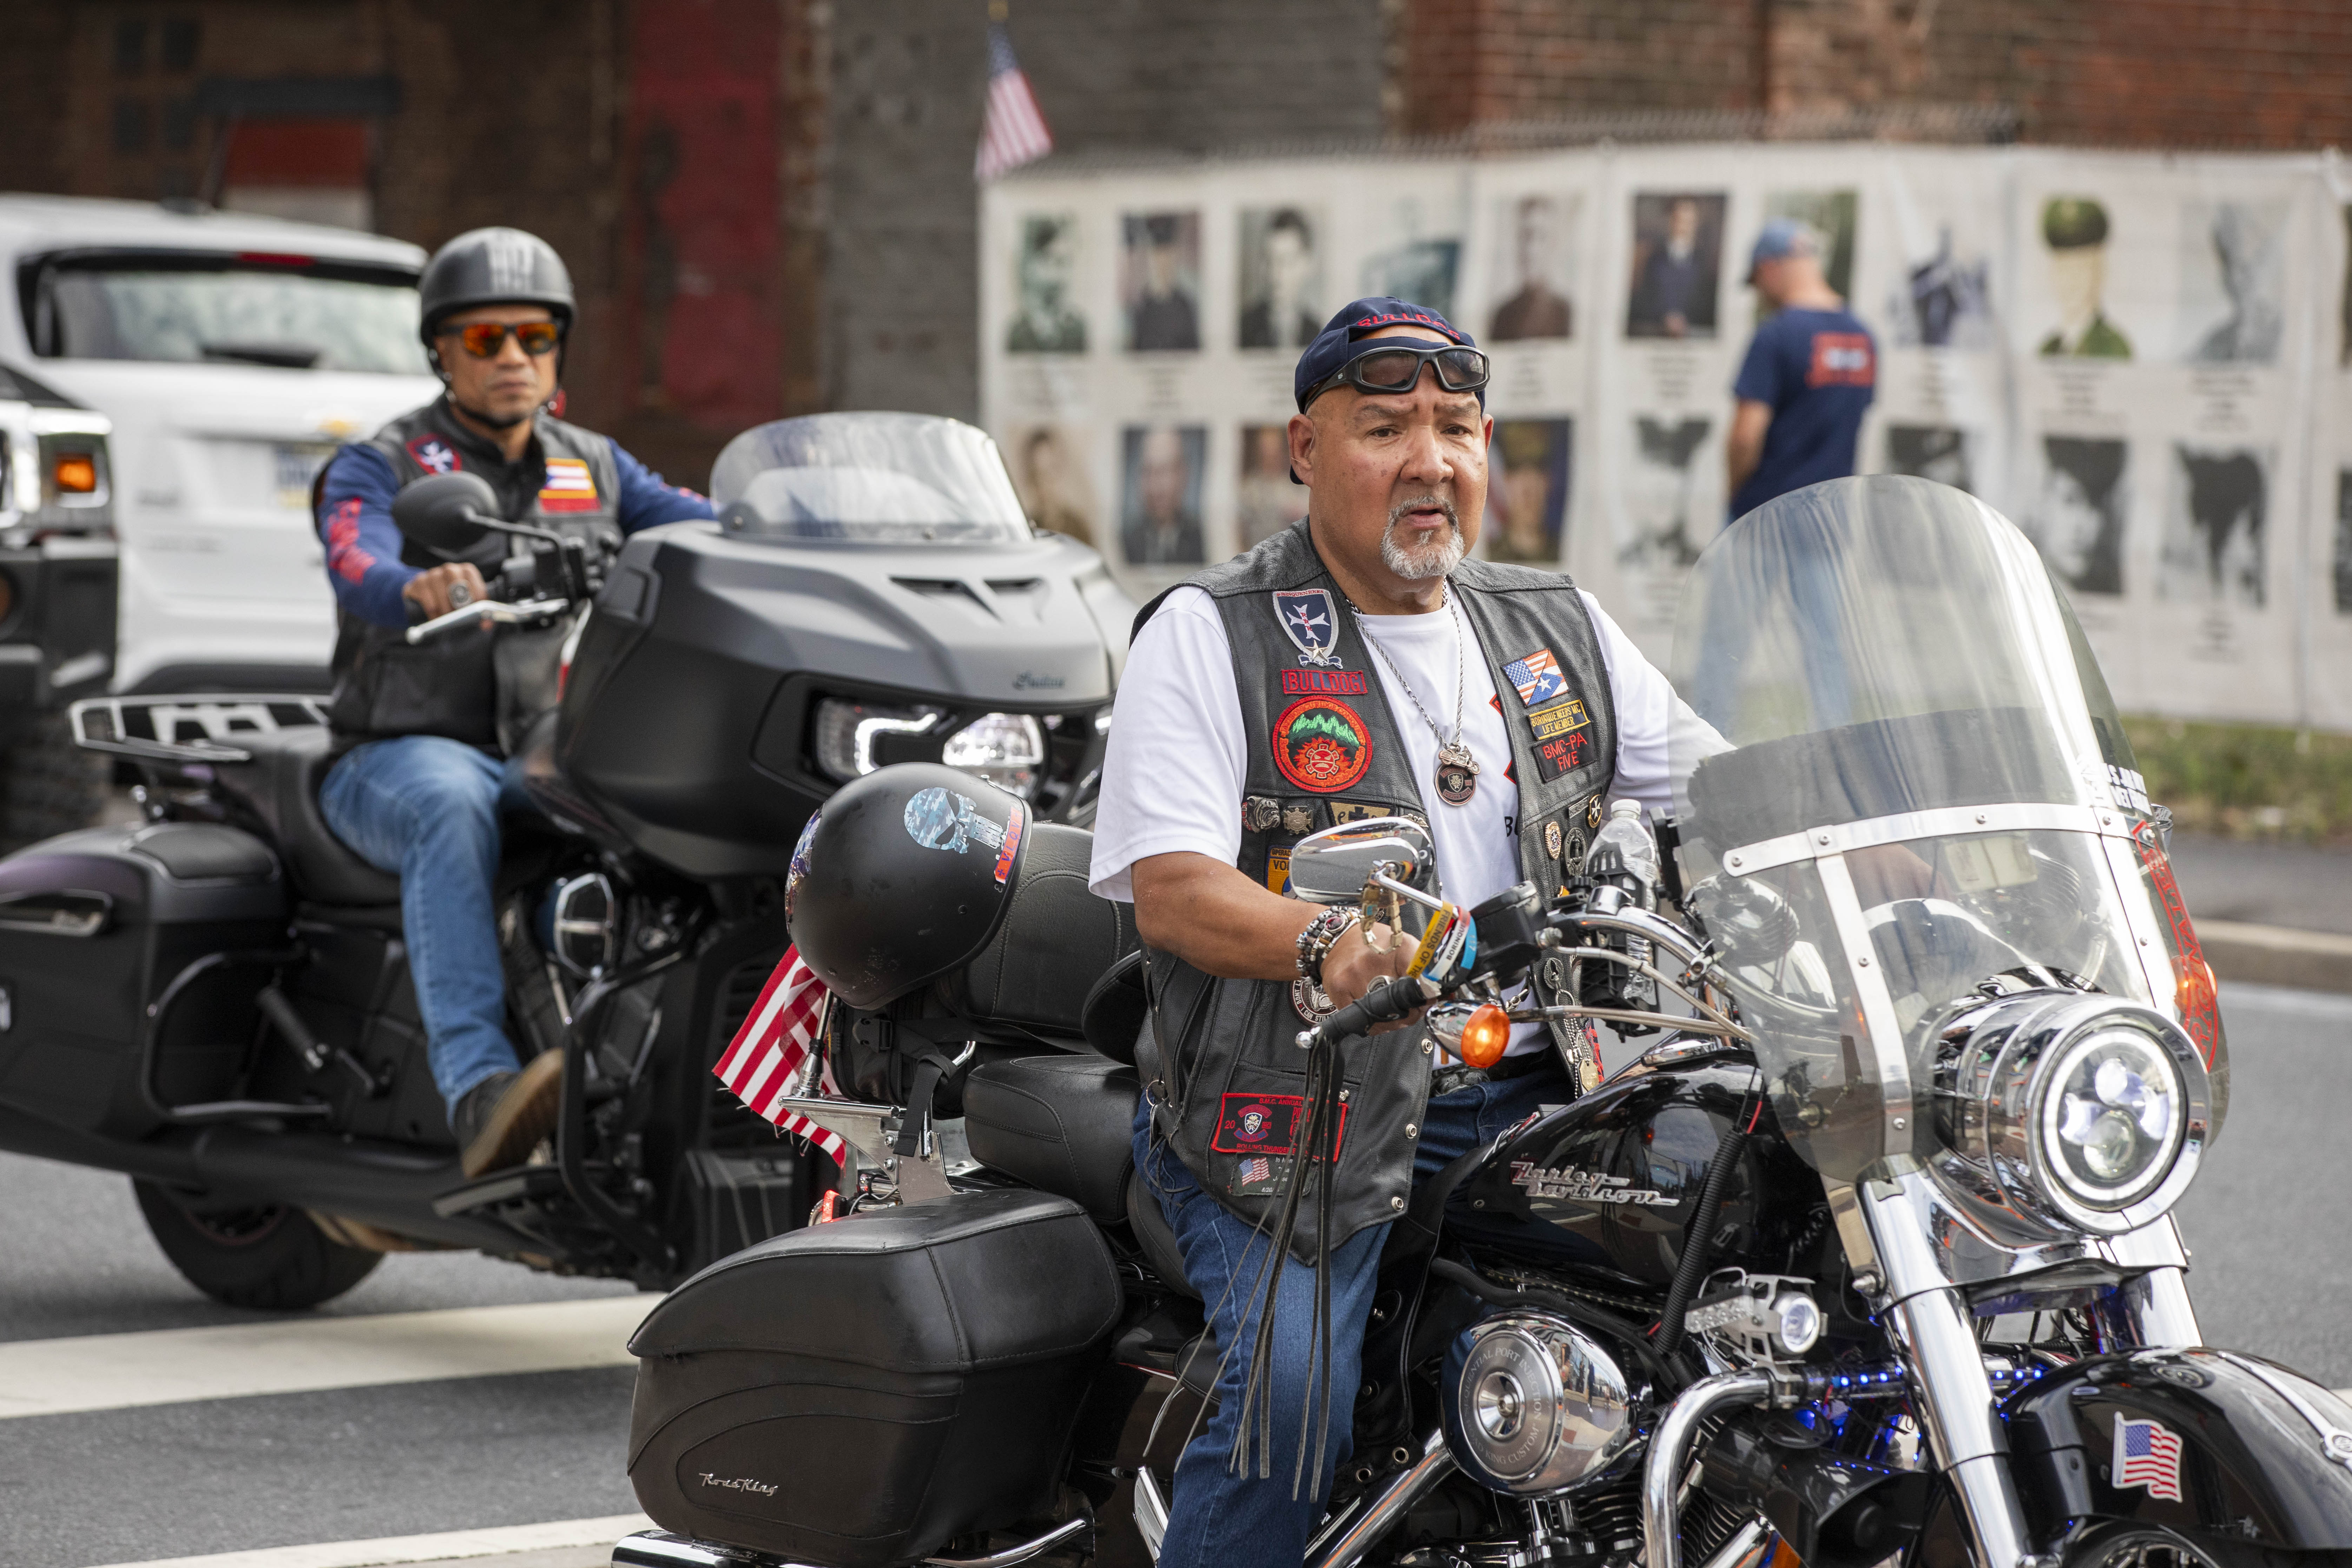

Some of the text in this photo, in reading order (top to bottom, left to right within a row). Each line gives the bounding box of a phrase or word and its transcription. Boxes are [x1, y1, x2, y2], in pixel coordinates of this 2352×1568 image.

[1357, 313, 1461, 341] BULLDOG
[1288, 672, 1362, 693] BULLDOG
[1570, 704, 1581, 714] MC
[1542, 717, 1575, 734] LIFE MEMBER
[1542, 732, 1587, 759] BMC-PA
[1557, 751, 1579, 771] FIVE
[1427, 909, 1451, 950] FRIENDS
[1421, 951, 1430, 964] OF
[1304, 1010, 1313, 1020] CAN
[1495, 1347, 1520, 1361] PORT
[1519, 1359, 1542, 1421] INJECTION
[1485, 1450, 1506, 1464] KING
[1508, 1427, 1539, 1464] CUSTOM
